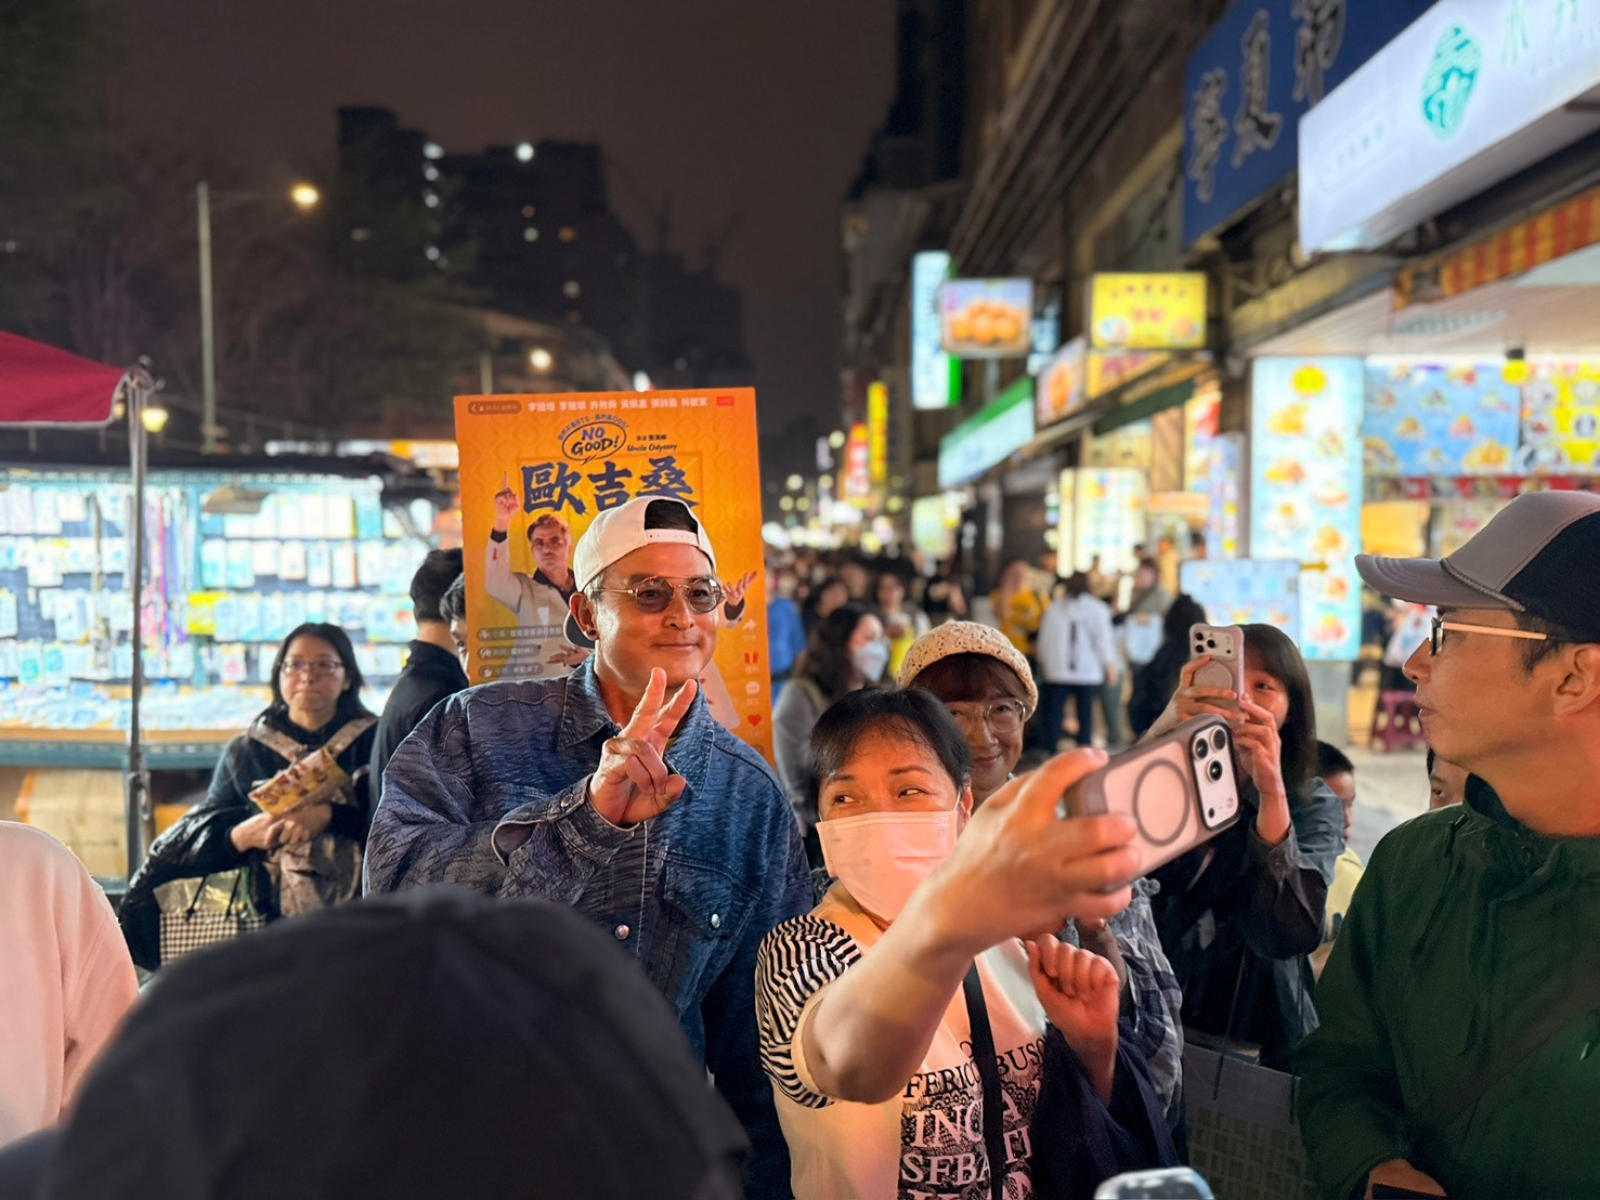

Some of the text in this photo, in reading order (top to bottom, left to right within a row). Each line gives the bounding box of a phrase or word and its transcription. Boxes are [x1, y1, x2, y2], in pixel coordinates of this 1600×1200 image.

[581, 426, 605, 441] NO
[571, 435, 620, 455] GOOD!
[520, 455, 700, 516] 歐吉桑
